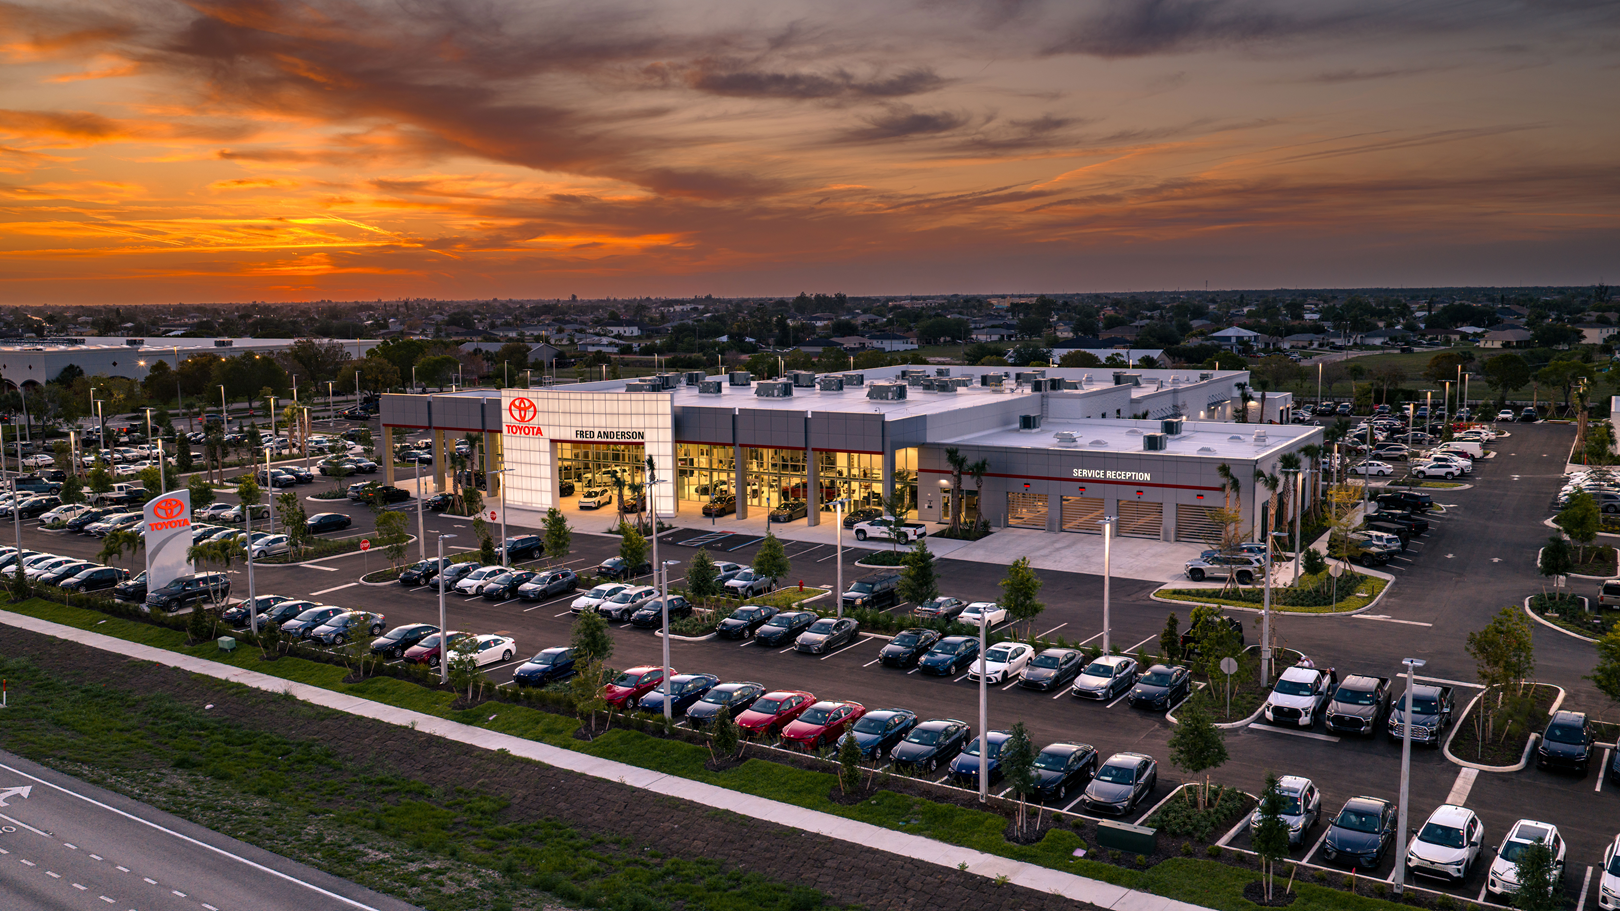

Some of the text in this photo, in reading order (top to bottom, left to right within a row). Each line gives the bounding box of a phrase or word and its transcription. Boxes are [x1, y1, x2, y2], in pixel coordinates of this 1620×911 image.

[505, 424, 543, 436] TOYOTA
[575, 430, 645, 440] FRED ANDERSON
[1073, 468, 1151, 481] SERVICE RECEPTION
[149, 518, 190, 531] TOYOTA
